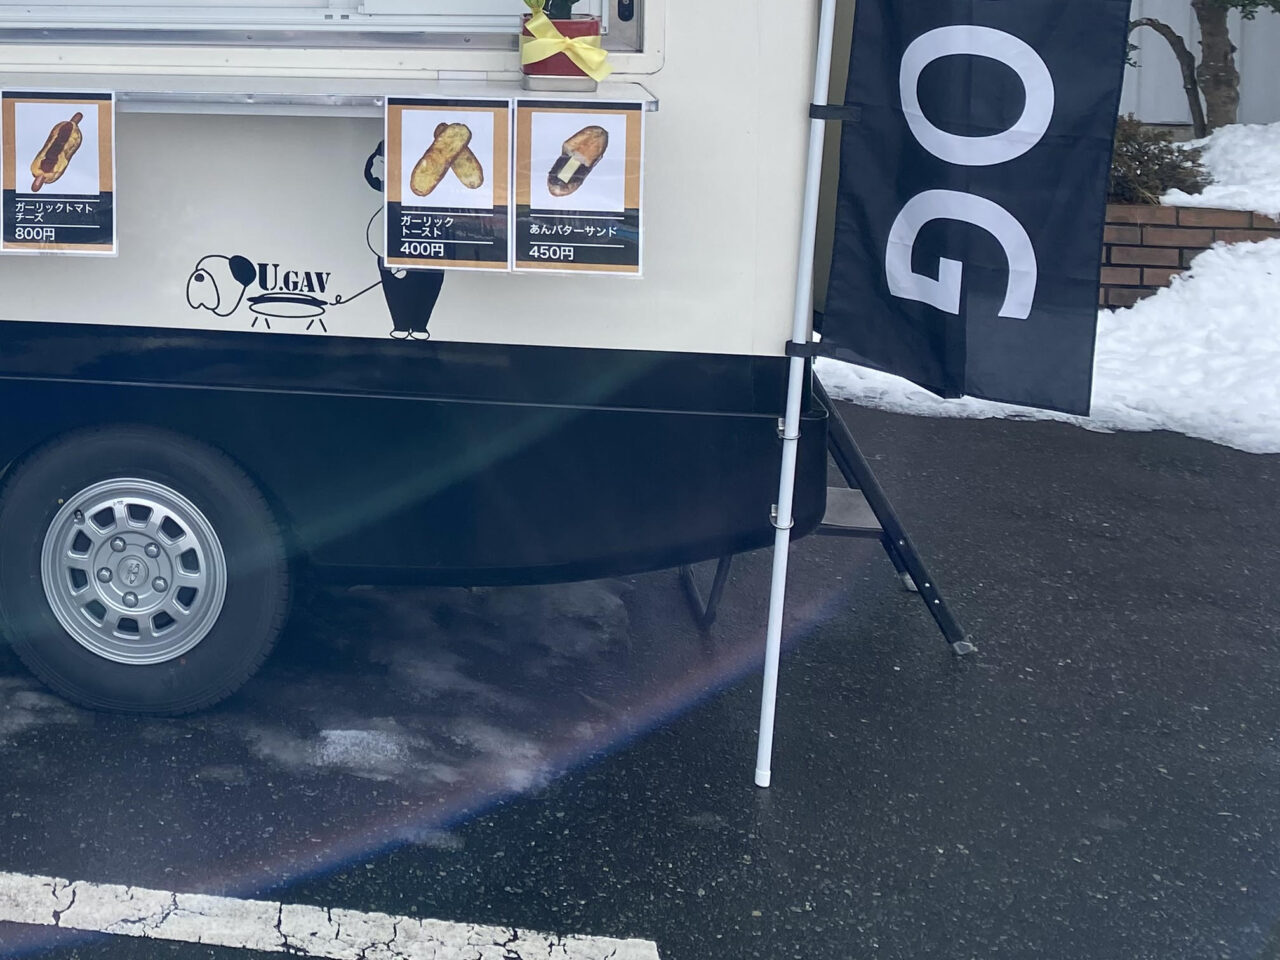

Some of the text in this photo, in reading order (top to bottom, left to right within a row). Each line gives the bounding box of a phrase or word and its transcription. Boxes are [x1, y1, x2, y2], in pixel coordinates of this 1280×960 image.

[15, 202, 94, 213] ガーリックトマト
[15, 212, 44, 222] チーズ
[400, 216, 454, 227] ガーリック
[15, 227, 55, 241] 800円
[401, 227, 442, 238] トースト
[529, 224, 618, 237] あんバターサンド
[400, 243, 444, 257] 400円
[529, 246, 574, 261] 450円
[256, 262, 331, 293] U.GAV
